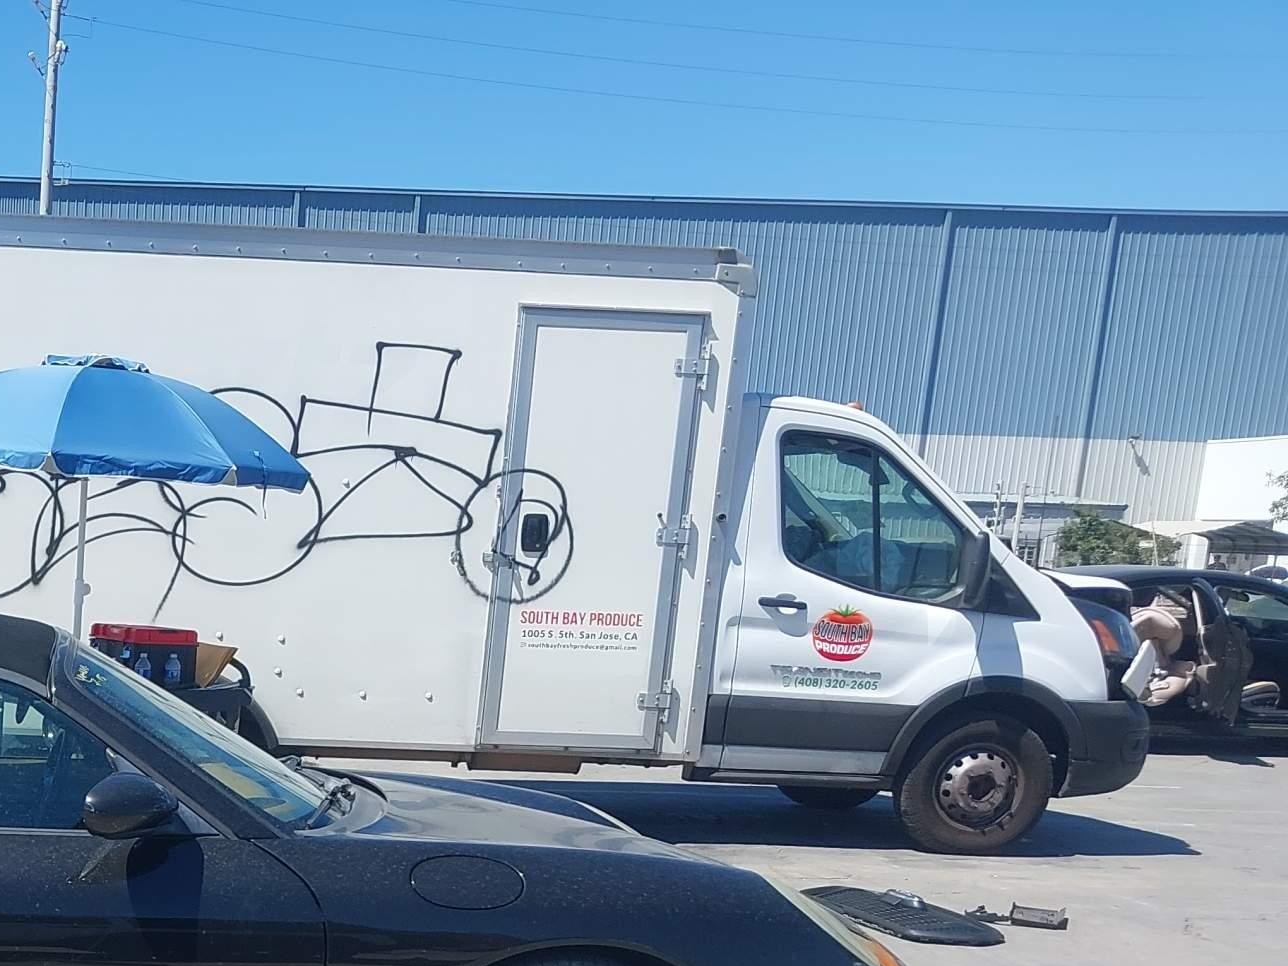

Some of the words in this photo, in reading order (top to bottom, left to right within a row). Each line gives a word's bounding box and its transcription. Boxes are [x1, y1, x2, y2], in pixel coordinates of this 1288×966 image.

[520, 611, 559, 625] SOUTH
[562, 611, 586, 625] BAY
[589, 612, 644, 627] PRODUCE
[521, 629, 546, 638] 1005
[579, 630, 596, 640] San
[598, 631, 622, 641] Jose,
[624, 632, 638, 641] CA
[814, 619, 848, 641] SOUTH
[850, 623, 870, 642] BAY
[814, 640, 869, 655] PRODUCE
[794, 676, 823, 690] (408)
[824, 678, 879, 691] 320-2605
